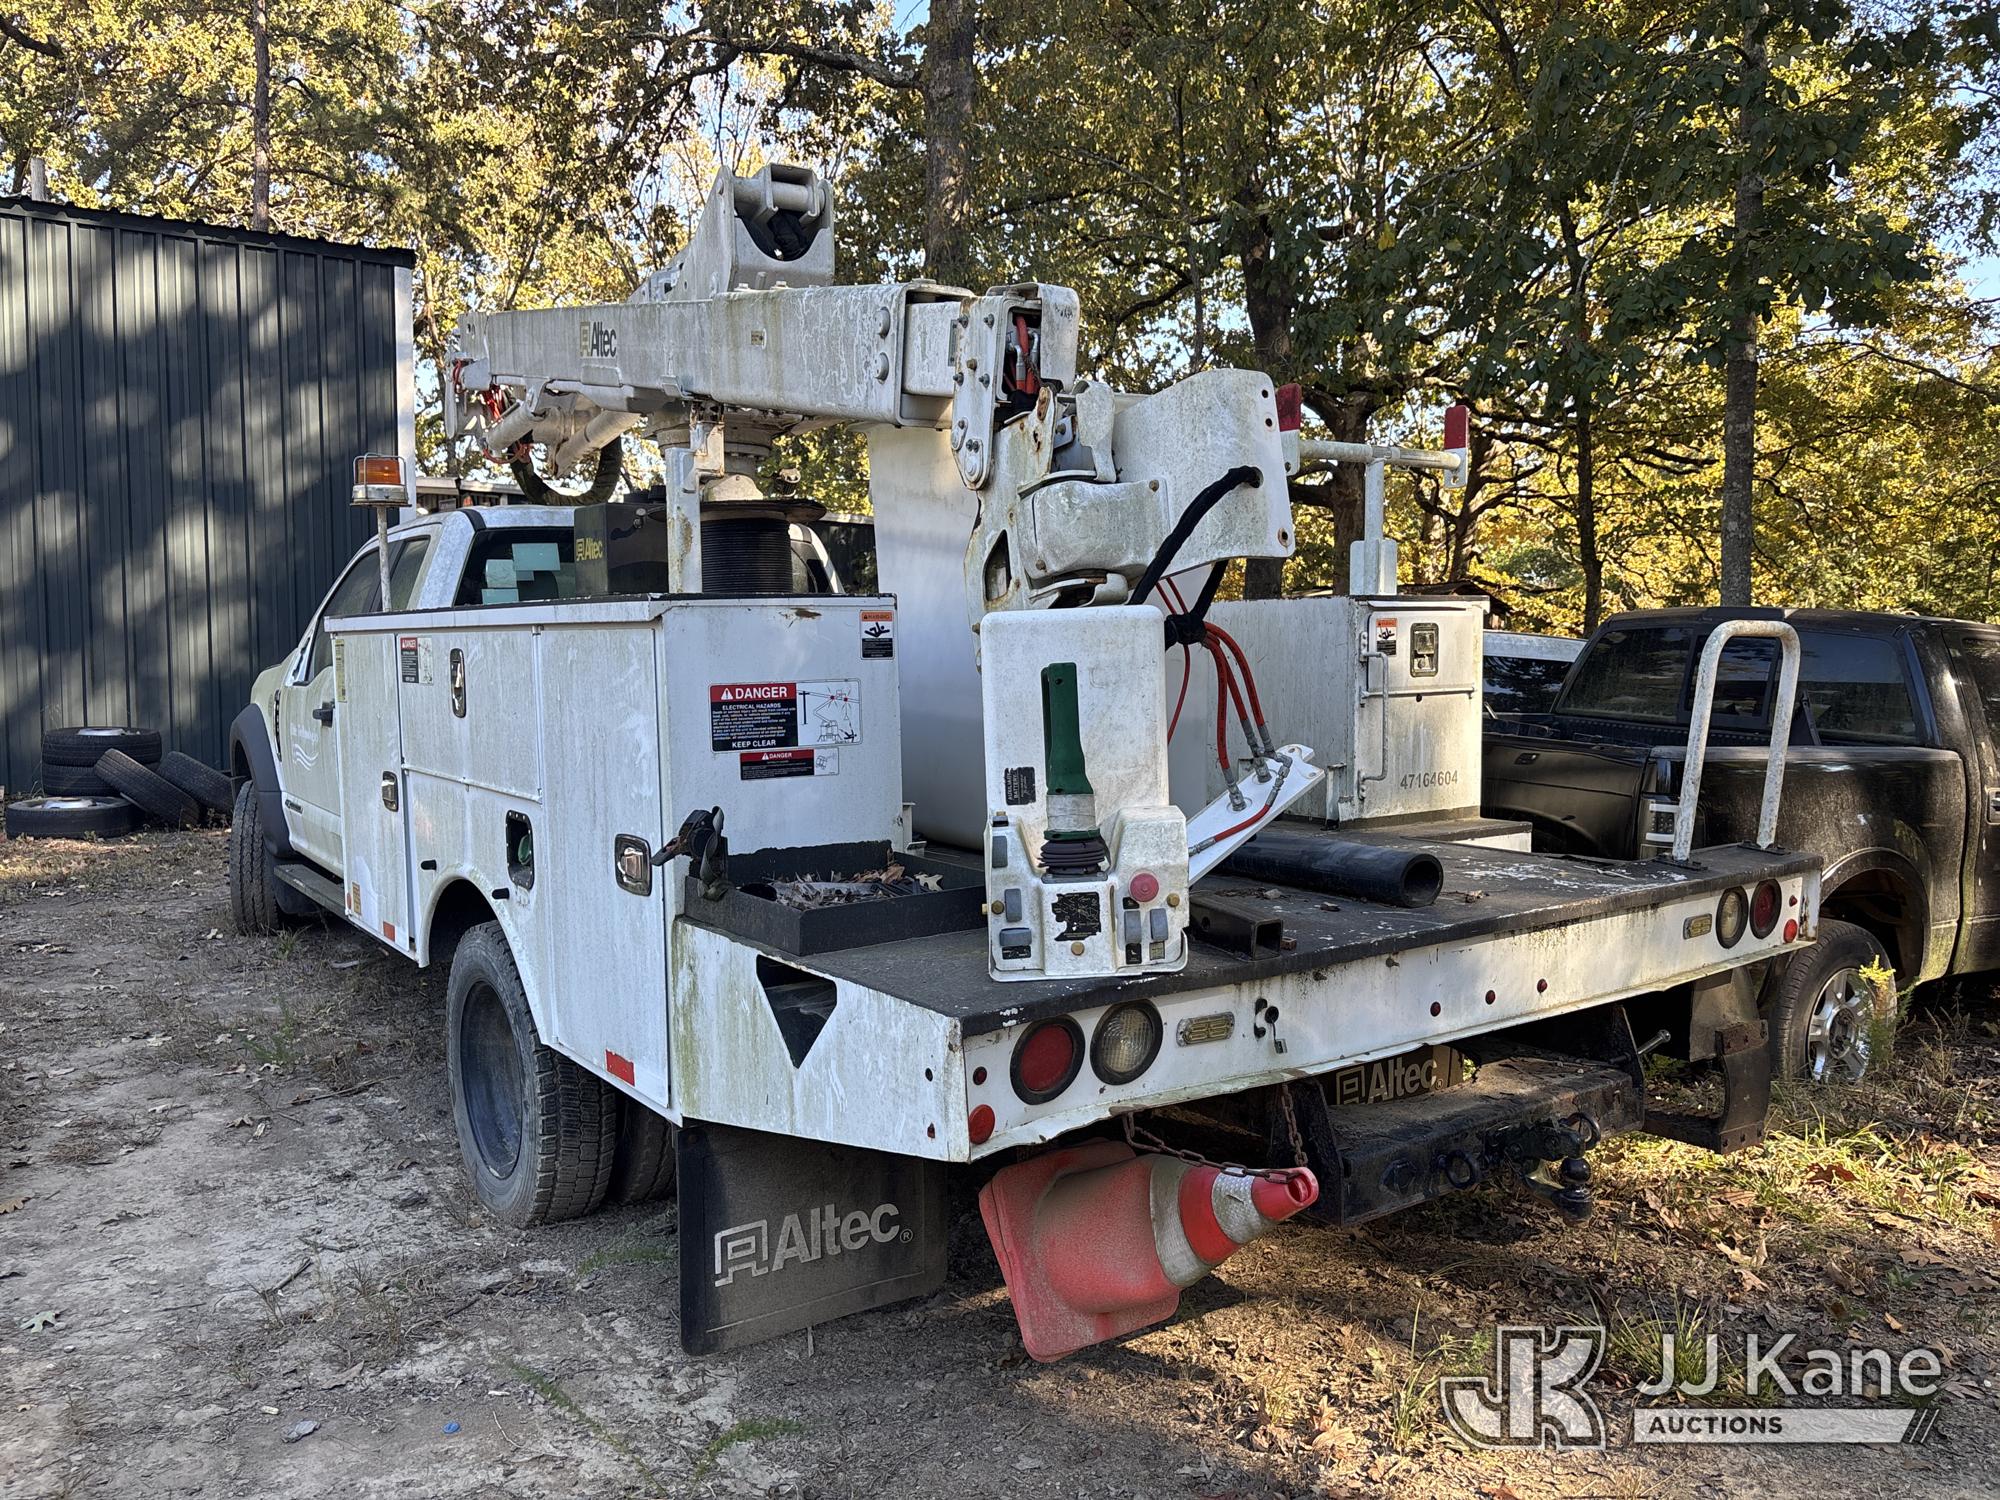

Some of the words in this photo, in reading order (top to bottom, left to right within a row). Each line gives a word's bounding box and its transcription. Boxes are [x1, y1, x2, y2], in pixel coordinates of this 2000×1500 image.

[591, 321, 617, 357] Altec
[585, 538, 603, 559] Altec
[735, 686, 788, 700] DANGER
[732, 740, 752, 748] KEEP
[752, 739, 776, 747] CLEAR
[1400, 770, 1458, 790] 47164604
[1367, 1056, 1438, 1105] Altec
[771, 1203, 900, 1272] Altec
